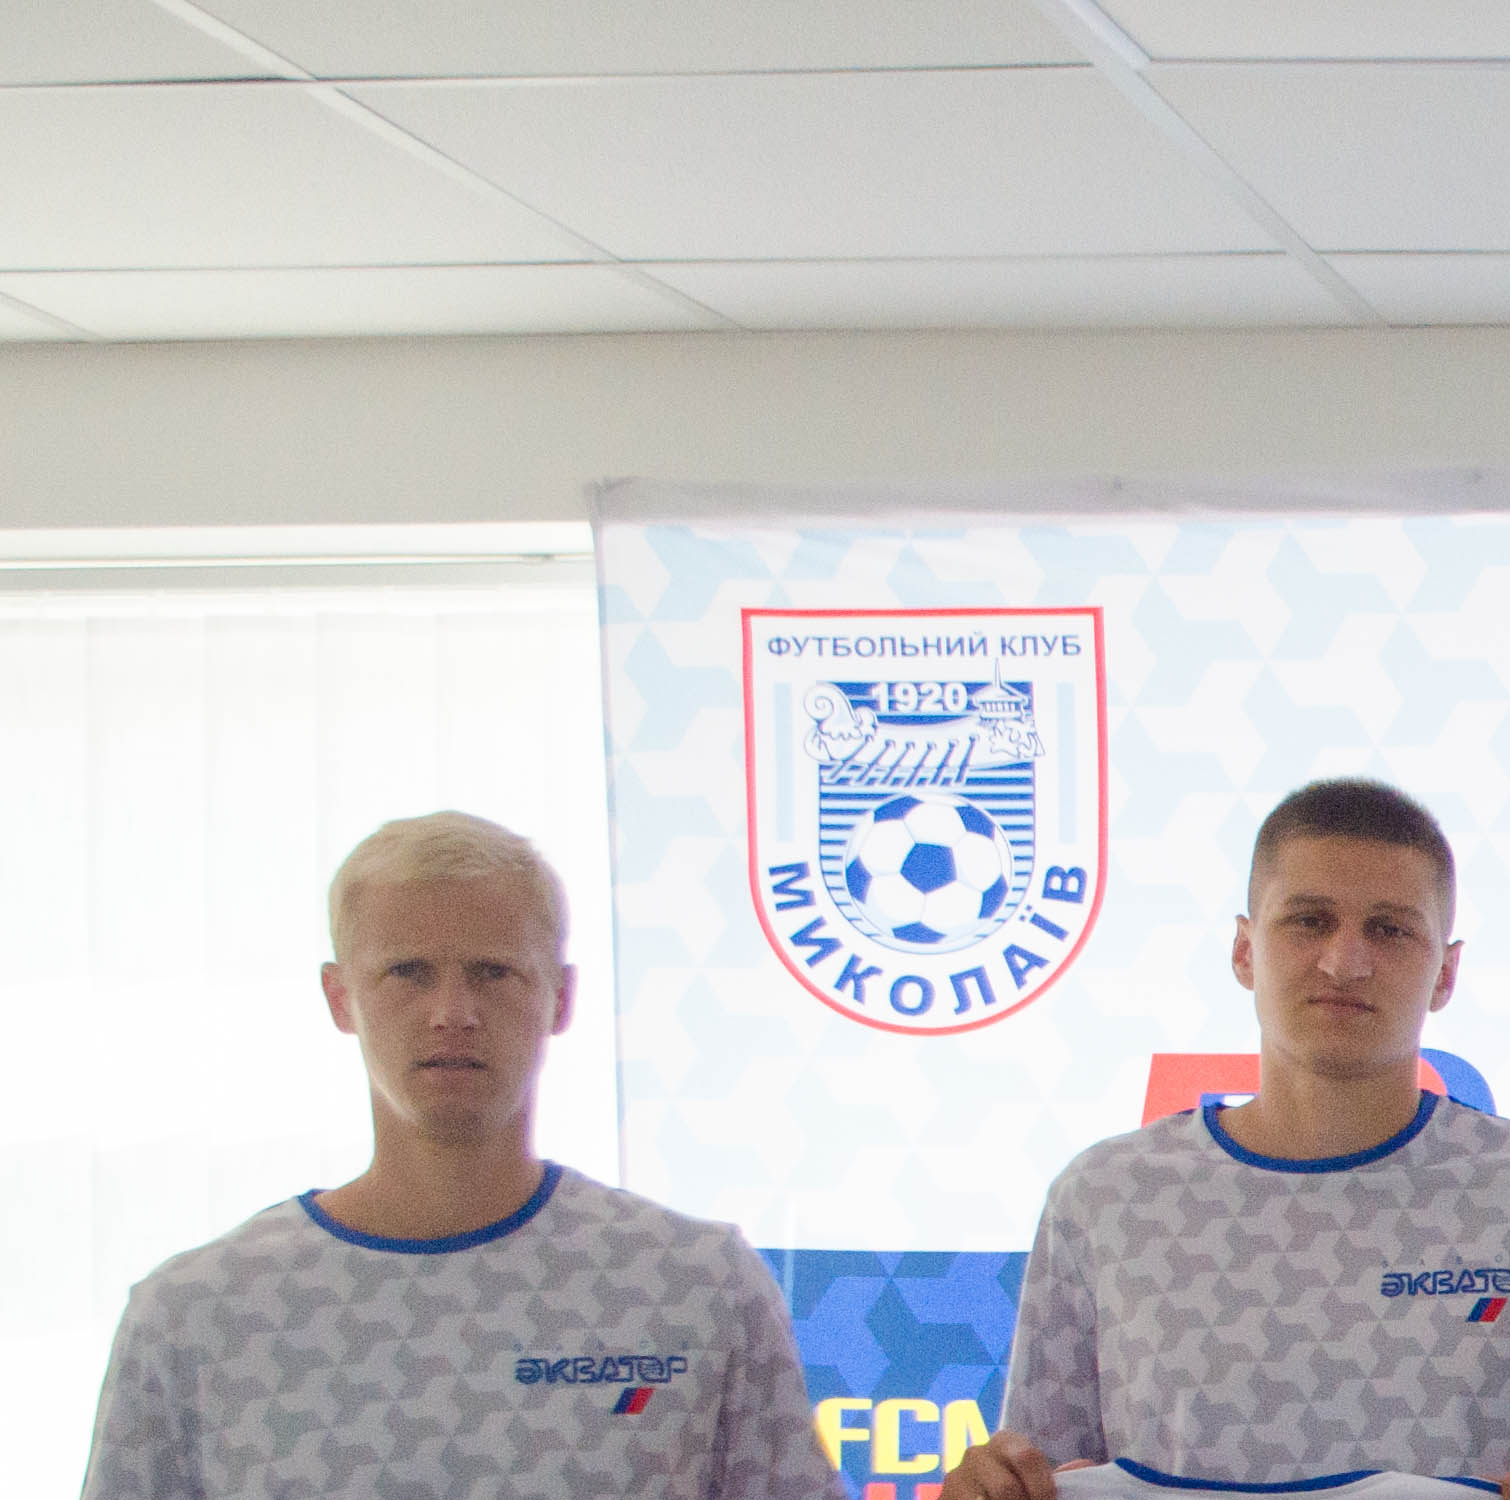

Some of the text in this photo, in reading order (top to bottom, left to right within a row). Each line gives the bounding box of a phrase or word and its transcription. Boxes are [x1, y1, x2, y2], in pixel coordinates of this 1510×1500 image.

[767, 631, 1081, 657] ФУТБОЛЬНИЙ КЛУБ
[871, 681, 967, 713] 1920
[769, 858, 1088, 1016] МИКОЛАЇВ
[515, 1355, 688, 1385] ЭКВАТОР
